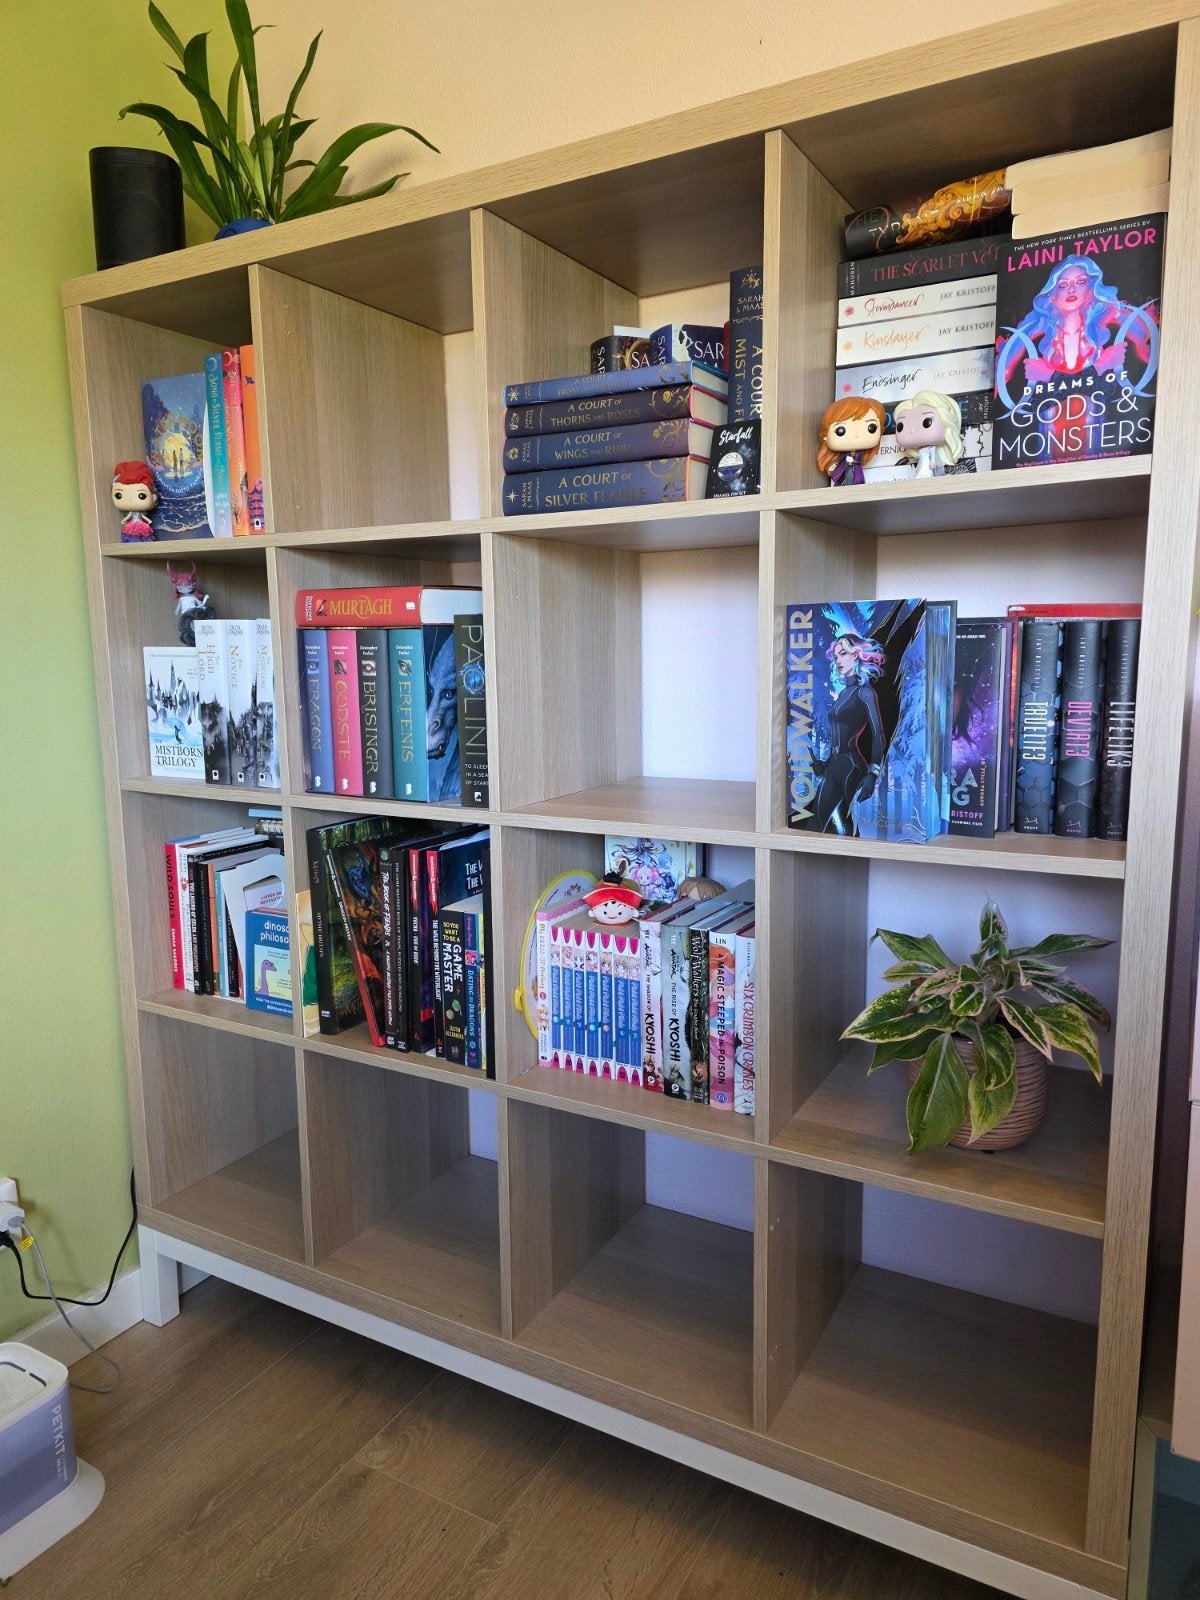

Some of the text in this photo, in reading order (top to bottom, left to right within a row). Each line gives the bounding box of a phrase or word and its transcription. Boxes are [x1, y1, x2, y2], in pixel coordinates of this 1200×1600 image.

[1026, 241, 1039, 249] NEW
[1059, 234, 1076, 242] TIMES
[1077, 225, 1118, 238] BESTSELLING
[1120, 221, 1140, 230] SERIES
[1007, 228, 1157, 272] LAINI TAYLOR
[871, 252, 968, 282] THE SCARLET
[738, 294, 763, 304] SARAH
[940, 285, 996, 301] JAY KRISTOFF
[742, 304, 764, 313] MAAS
[864, 325, 931, 350] Kinslayer
[938, 320, 995, 336] JAY KRISTOFF
[694, 341, 725, 360] SAR
[582, 374, 606, 384] COURT
[734, 338, 747, 405] MIST AND
[750, 345, 763, 420] A COUR
[862, 368, 922, 394] Endsinger
[933, 371, 945, 380] JAY
[1023, 370, 1128, 396] DREAMS OF
[209, 374, 222, 457] SONG SILVER FLAME
[550, 413, 592, 427] THORNS
[607, 408, 640, 420] ROSES
[568, 404, 576, 413] A
[578, 398, 614, 411] COURT
[1010, 386, 1140, 428] GODS &
[564, 436, 572, 446] A
[574, 432, 612, 445] COURT
[718, 426, 754, 446] Starfall
[999, 417, 1152, 461] MONSTERS
[554, 448, 588, 460] WINGS
[558, 472, 633, 489] A COURT OF
[545, 486, 647, 508] SILVER FLAMES
[329, 595, 392, 620] MURTAGH
[206, 644, 216, 674] HIGH
[230, 644, 238, 690] NOVICE
[462, 625, 488, 756] PAOLINI
[309, 679, 322, 752] ERAGON
[335, 680, 350, 762] OUDSTE
[362, 680, 378, 774] BRISINGR
[397, 681, 414, 763] ERFENIS
[790, 609, 816, 824] VOIDWALKER
[155, 744, 204, 758] MISTBORN
[155, 756, 197, 768] TRILOGY
[952, 786, 970, 807] G
[950, 810, 984, 820] RISTOFF
[465, 862, 478, 876] THE
[466, 876, 478, 890] THE
[384, 903, 390, 912] OF
[260, 930, 289, 944] philoso
[383, 912, 392, 936] FIENDS
[442, 942, 454, 993] MASTER
[452, 944, 462, 982] GAME
[716, 960, 725, 992] MAGIC
[716, 994, 725, 1036] STEEPED
[645, 1014, 656, 1054] KYOSHI
[669, 1018, 680, 1062] KYOSHI
[742, 982, 755, 1091] SIX CRIMSON CRANES
[717, 1050, 726, 1085] POISON
[50, 1402, 66, 1455] PETKIT
